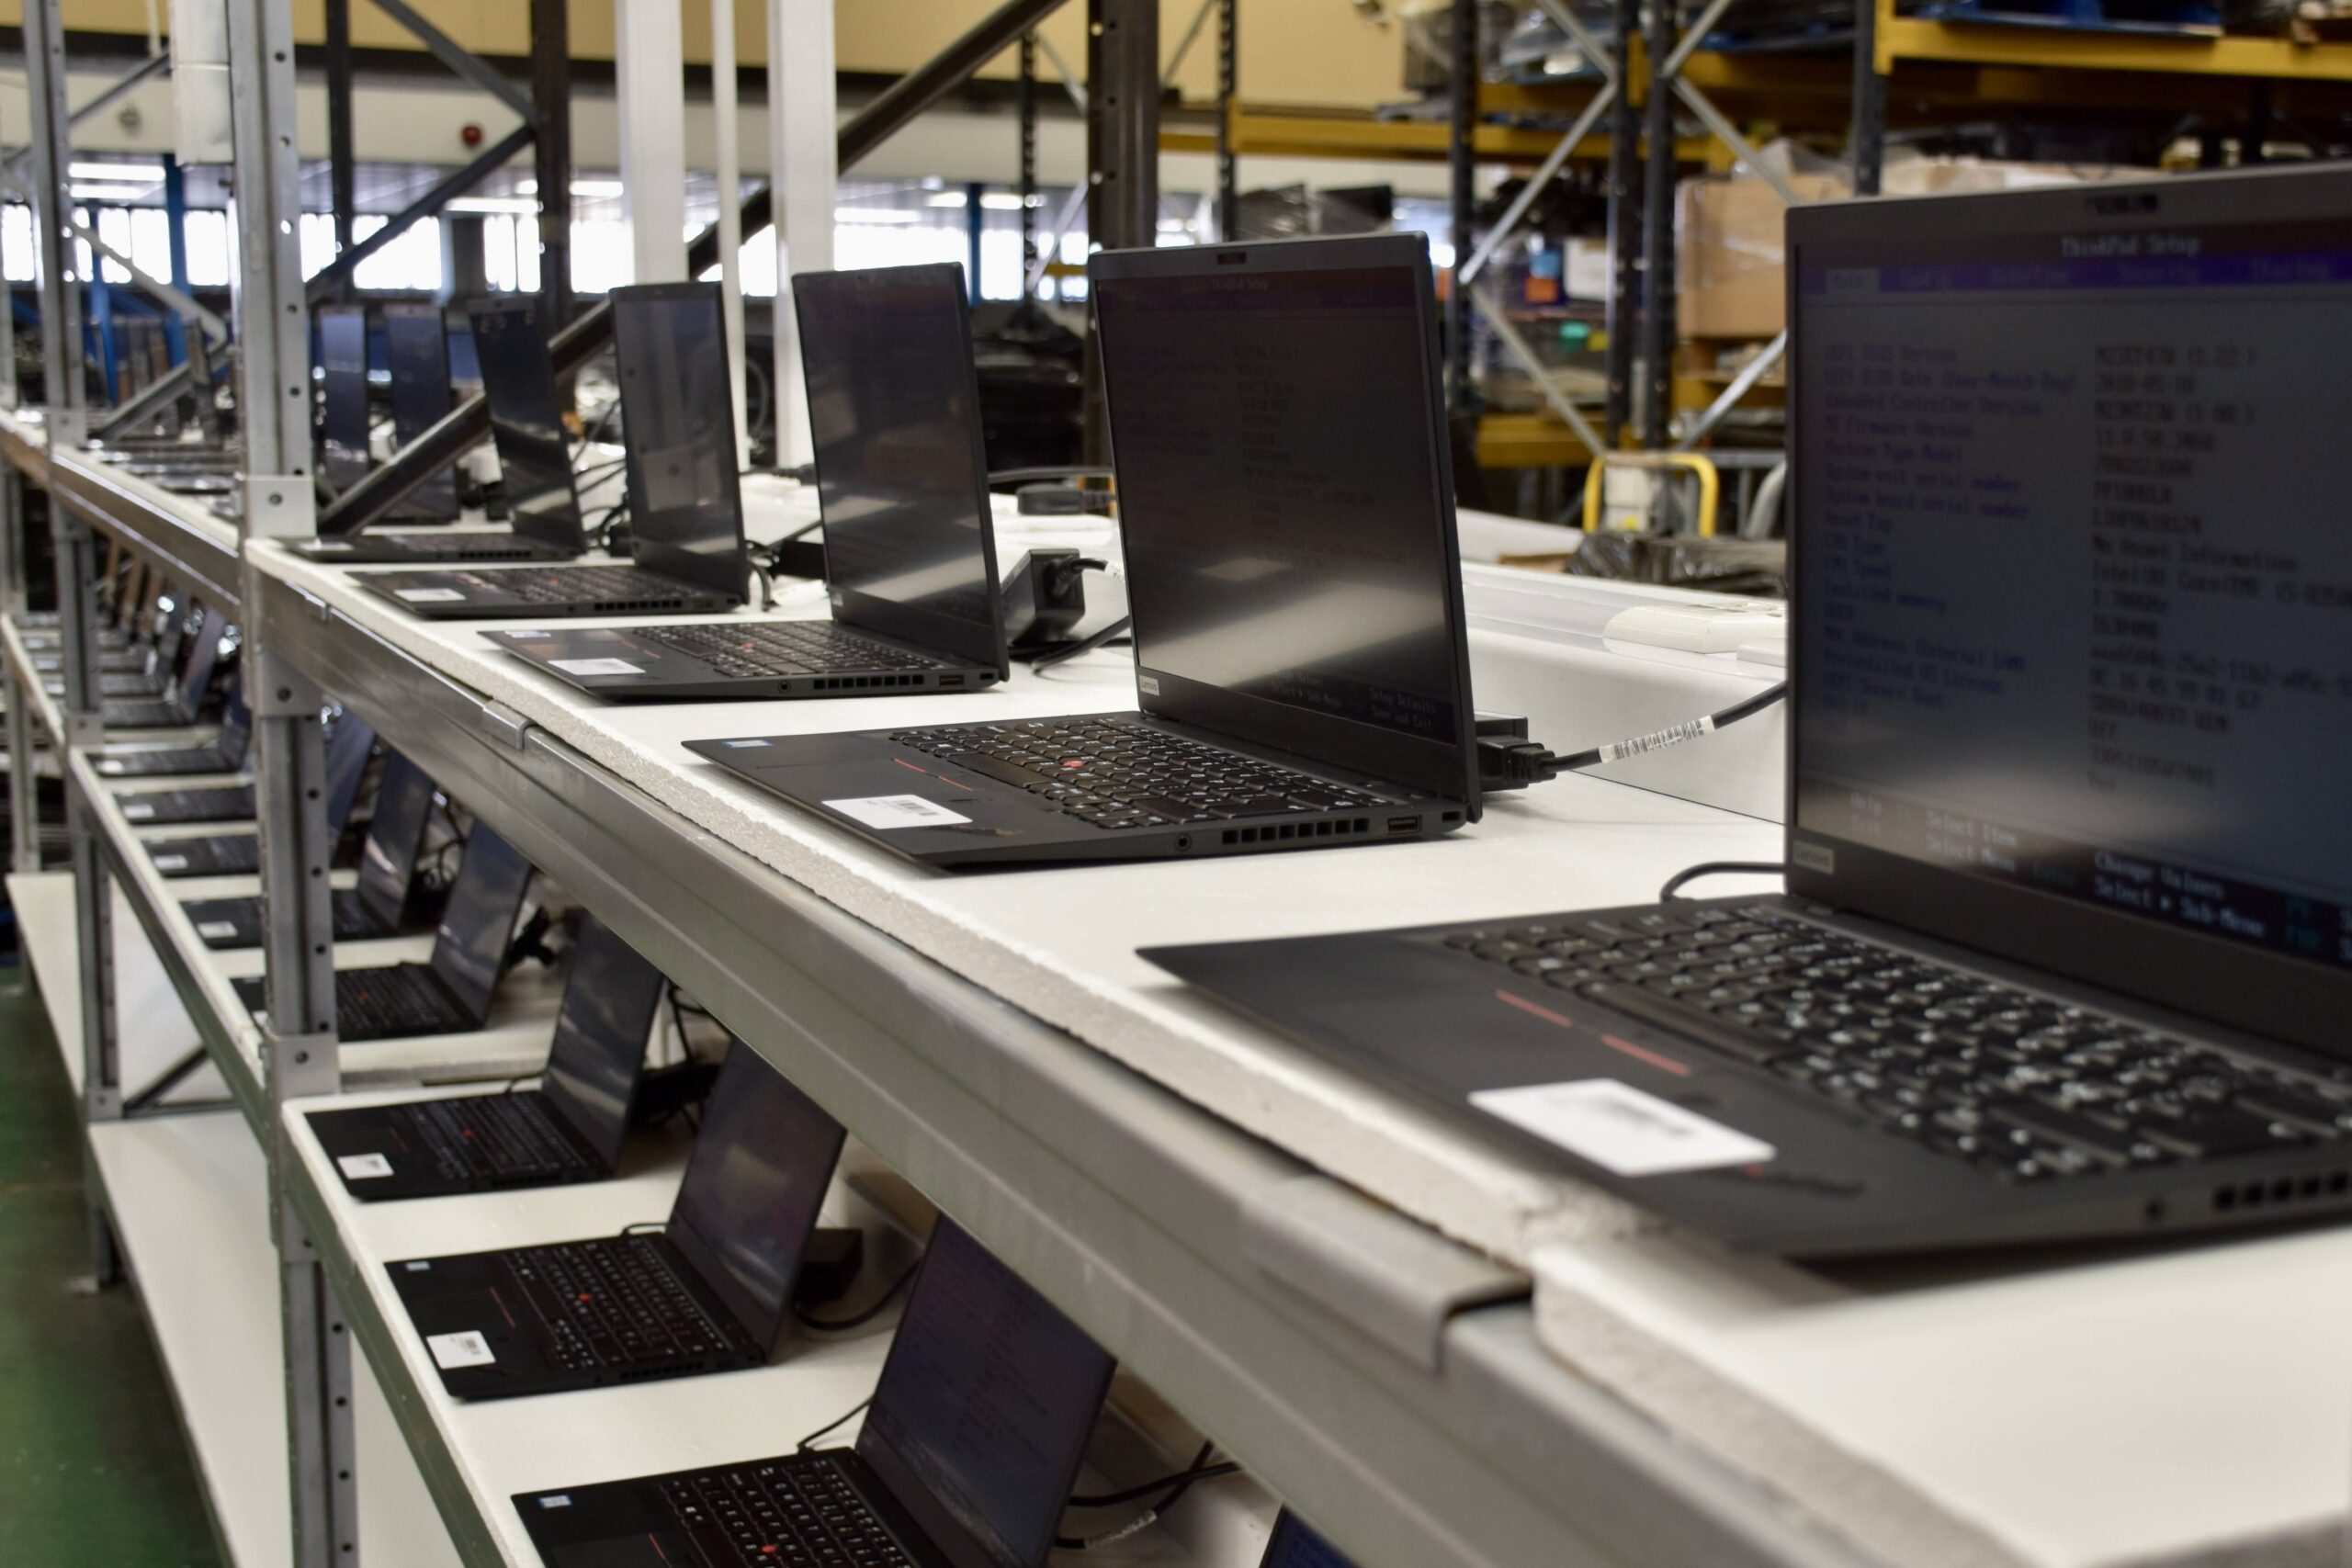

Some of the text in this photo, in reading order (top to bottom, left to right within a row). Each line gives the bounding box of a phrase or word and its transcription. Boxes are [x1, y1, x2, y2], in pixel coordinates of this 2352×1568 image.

[2062, 235, 2199, 258] ThinkPad Setup
[2094, 851, 2223, 899] Change Values
[2094, 874, 2151, 908] Select
